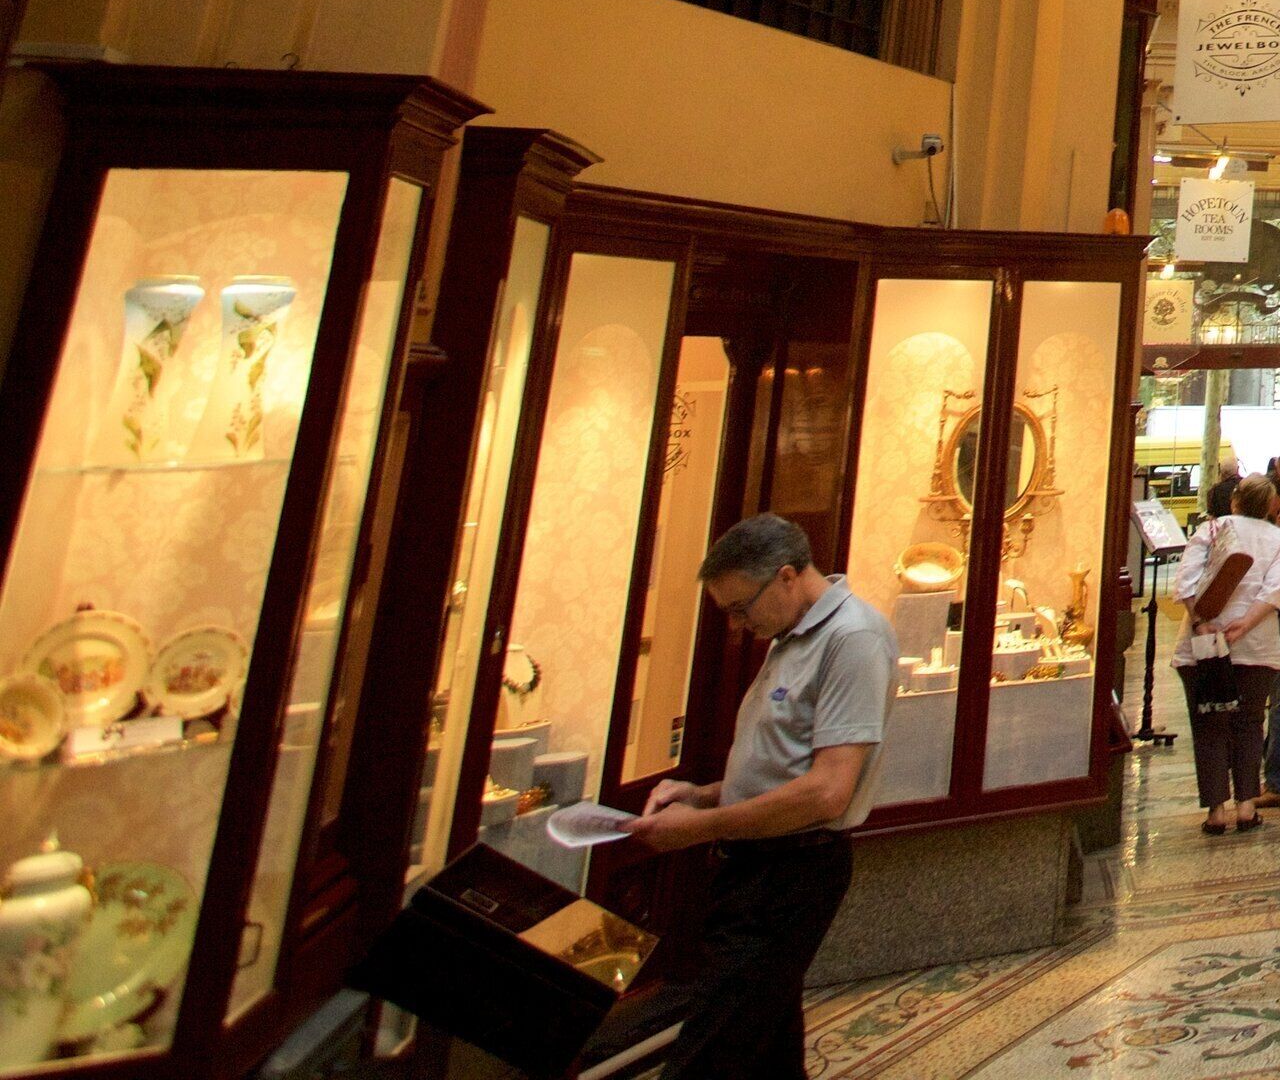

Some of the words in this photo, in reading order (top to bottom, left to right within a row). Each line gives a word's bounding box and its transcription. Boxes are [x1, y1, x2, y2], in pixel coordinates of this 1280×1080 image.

[1209, 18, 1232, 33] THE
[1203, 59, 1217, 71] THE
[1220, 68, 1247, 77] BLOCK
[1181, 197, 1249, 224] HOPETOUN
[1202, 213, 1225, 224] TEA
[1194, 224, 1233, 235] ROOMS
